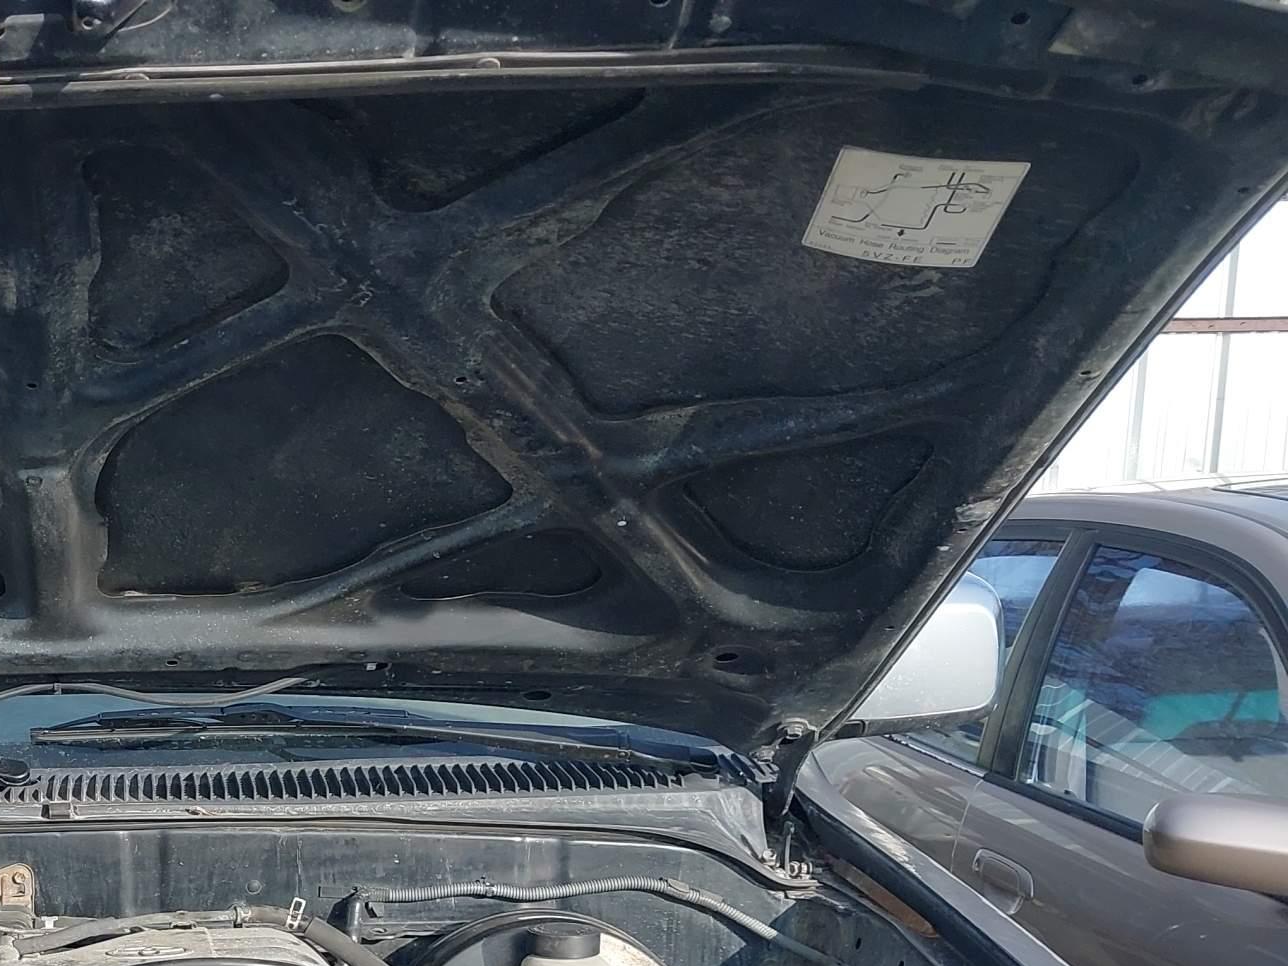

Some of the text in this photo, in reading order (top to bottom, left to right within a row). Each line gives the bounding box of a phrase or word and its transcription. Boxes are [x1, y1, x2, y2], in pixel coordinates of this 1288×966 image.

[818, 228, 971, 256] Vacuum Hose Routing Diagram
[862, 249, 923, 263] 5VZ-FE
